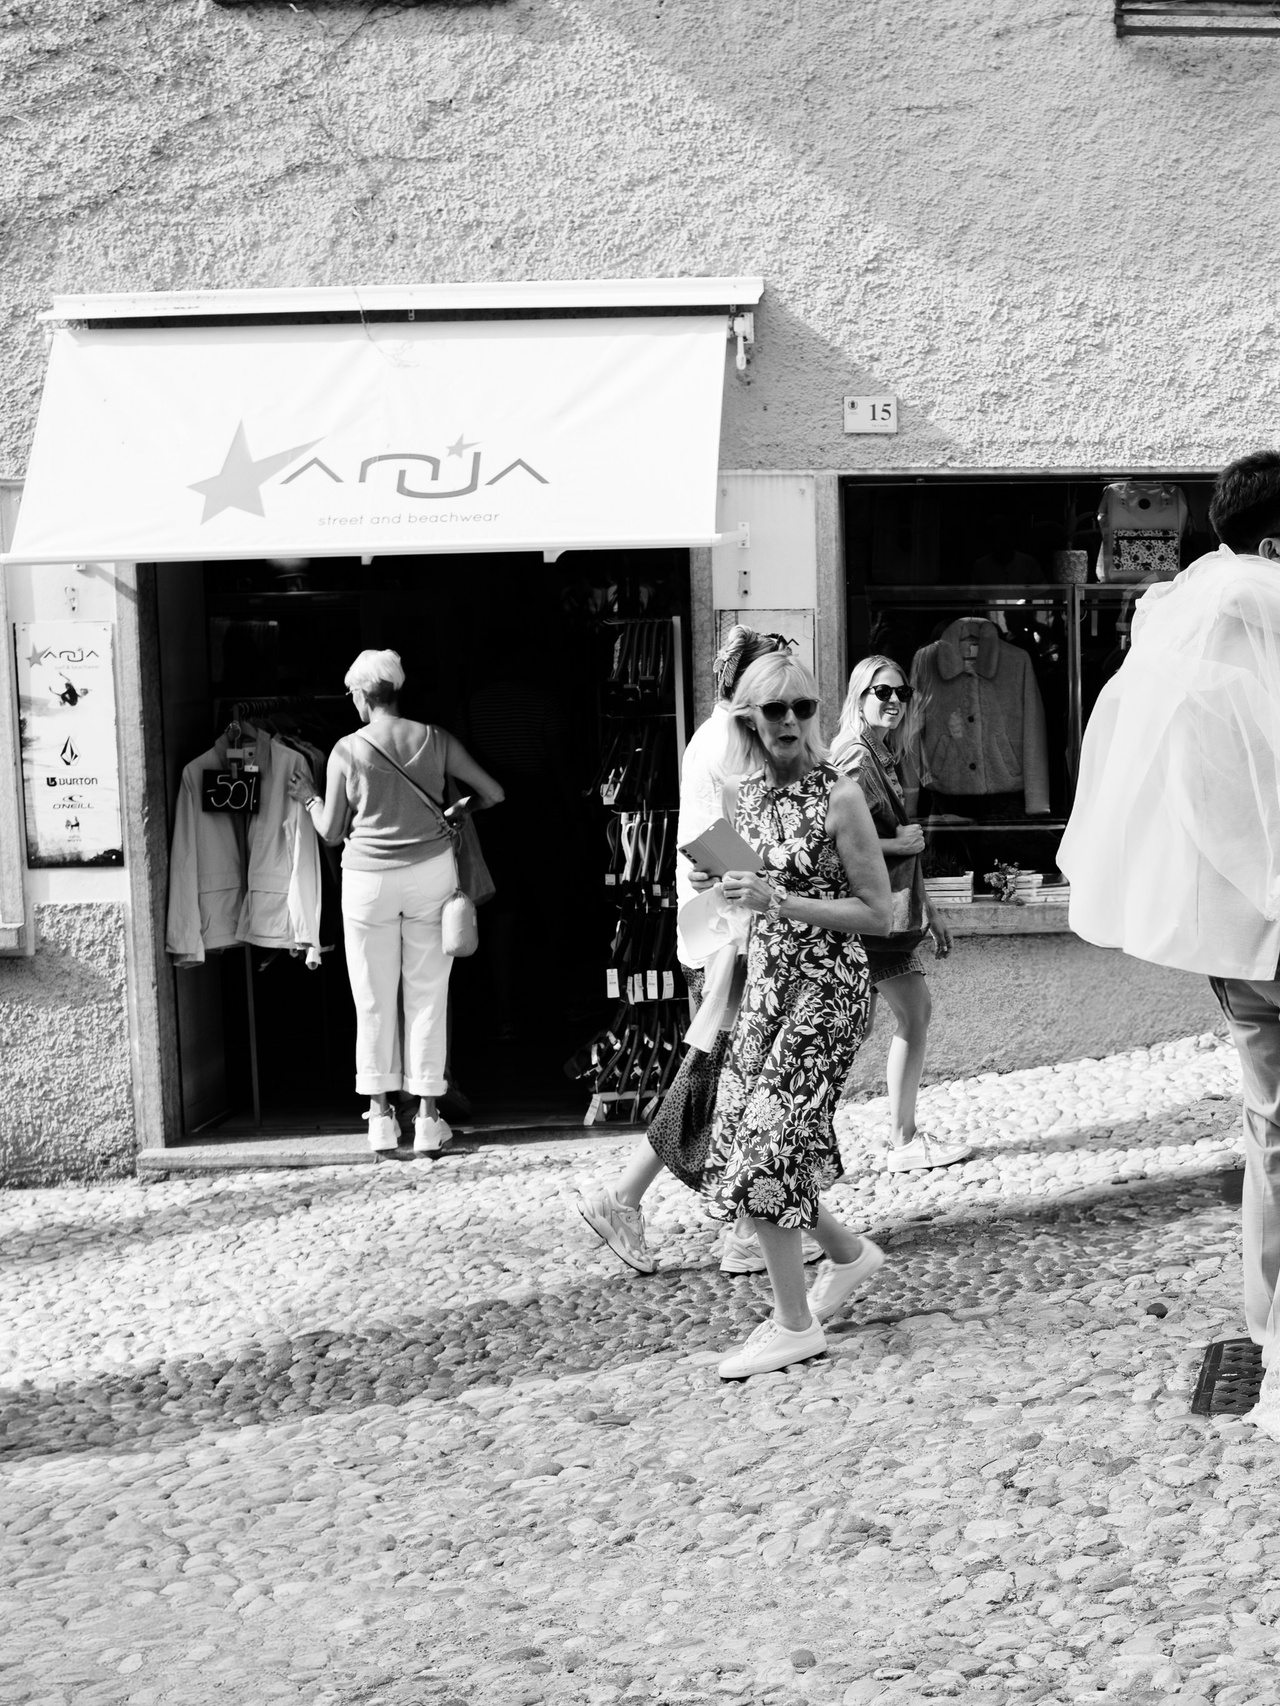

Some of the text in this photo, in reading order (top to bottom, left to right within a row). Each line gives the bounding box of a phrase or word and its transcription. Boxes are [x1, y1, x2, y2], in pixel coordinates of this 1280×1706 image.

[868, 403, 892, 421] 15
[317, 512, 501, 526] street and beachwear
[58, 777, 98, 786] BURTON
[206, 774, 257, 811] -50%
